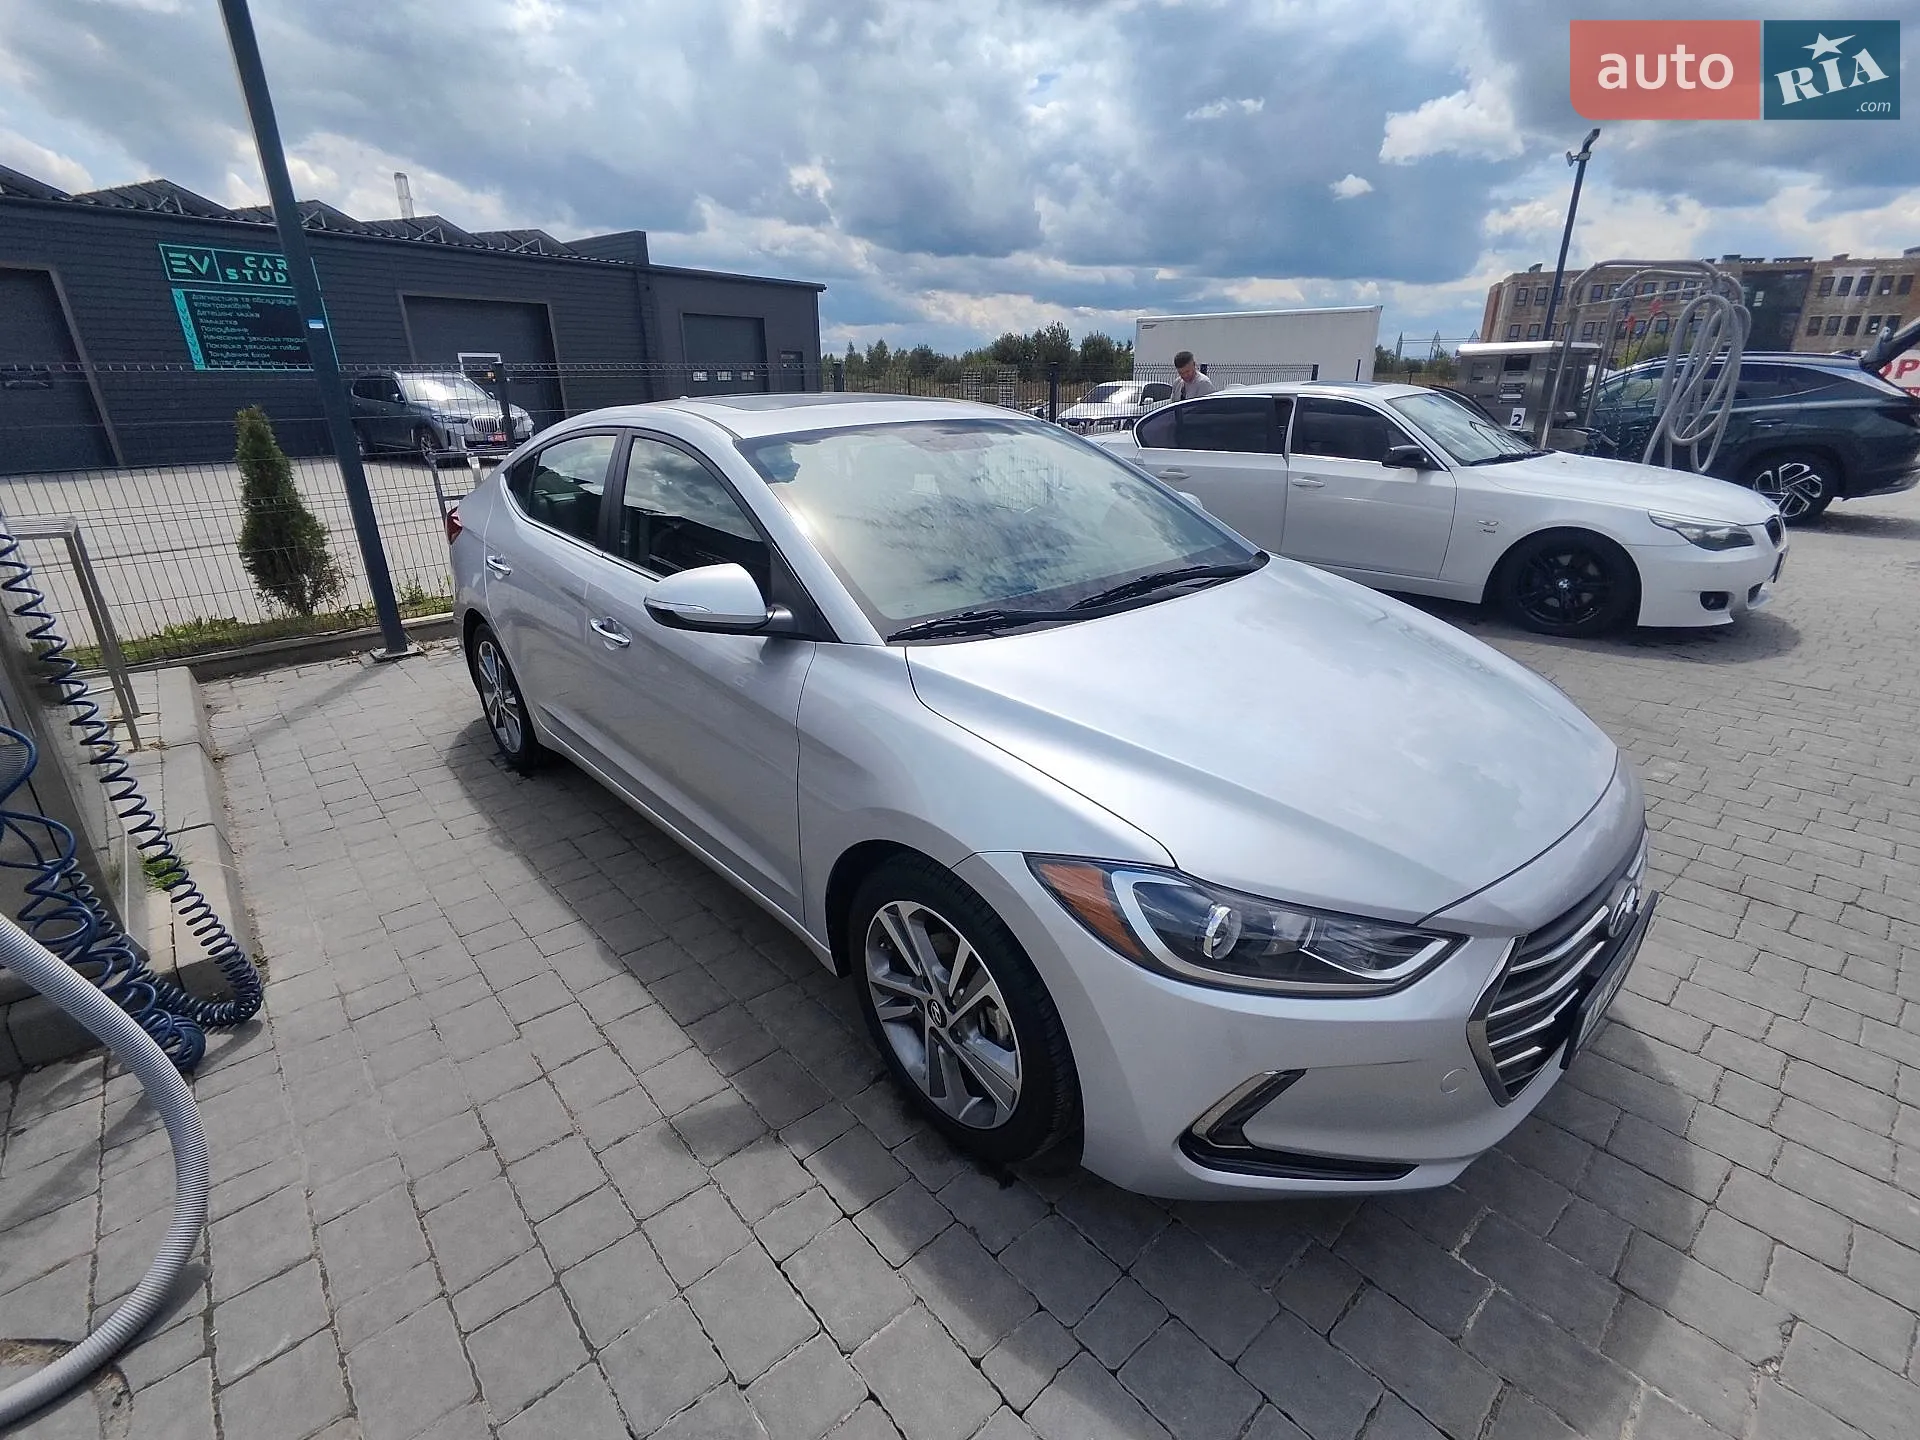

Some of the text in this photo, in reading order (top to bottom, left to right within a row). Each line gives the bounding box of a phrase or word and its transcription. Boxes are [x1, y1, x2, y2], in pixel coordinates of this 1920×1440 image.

[168, 252, 210, 275] EV
[244, 256, 288, 271] CAR
[225, 268, 287, 283] STUD
[1511, 413, 1523, 427] 2
